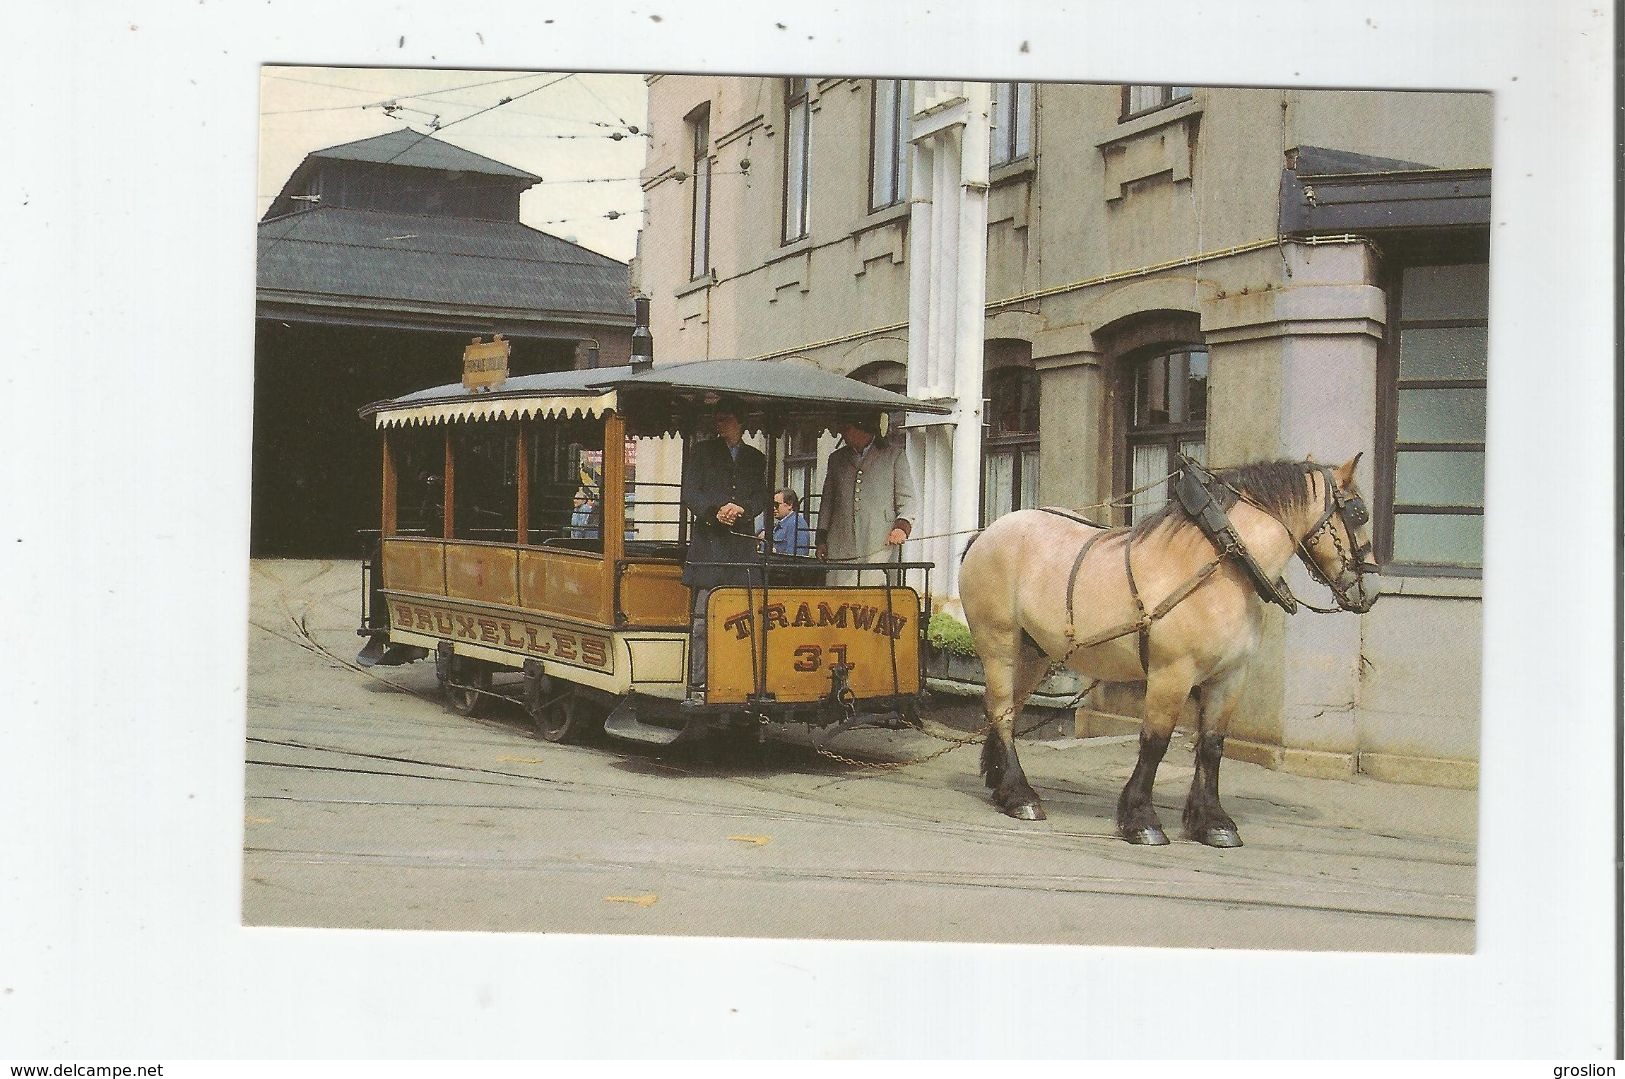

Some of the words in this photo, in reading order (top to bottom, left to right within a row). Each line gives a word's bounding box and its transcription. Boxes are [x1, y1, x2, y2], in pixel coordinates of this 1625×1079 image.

[395, 604, 607, 668] BRUXELLES
[723, 600, 908, 641] TRAMWAY
[793, 643, 856, 673] 31
